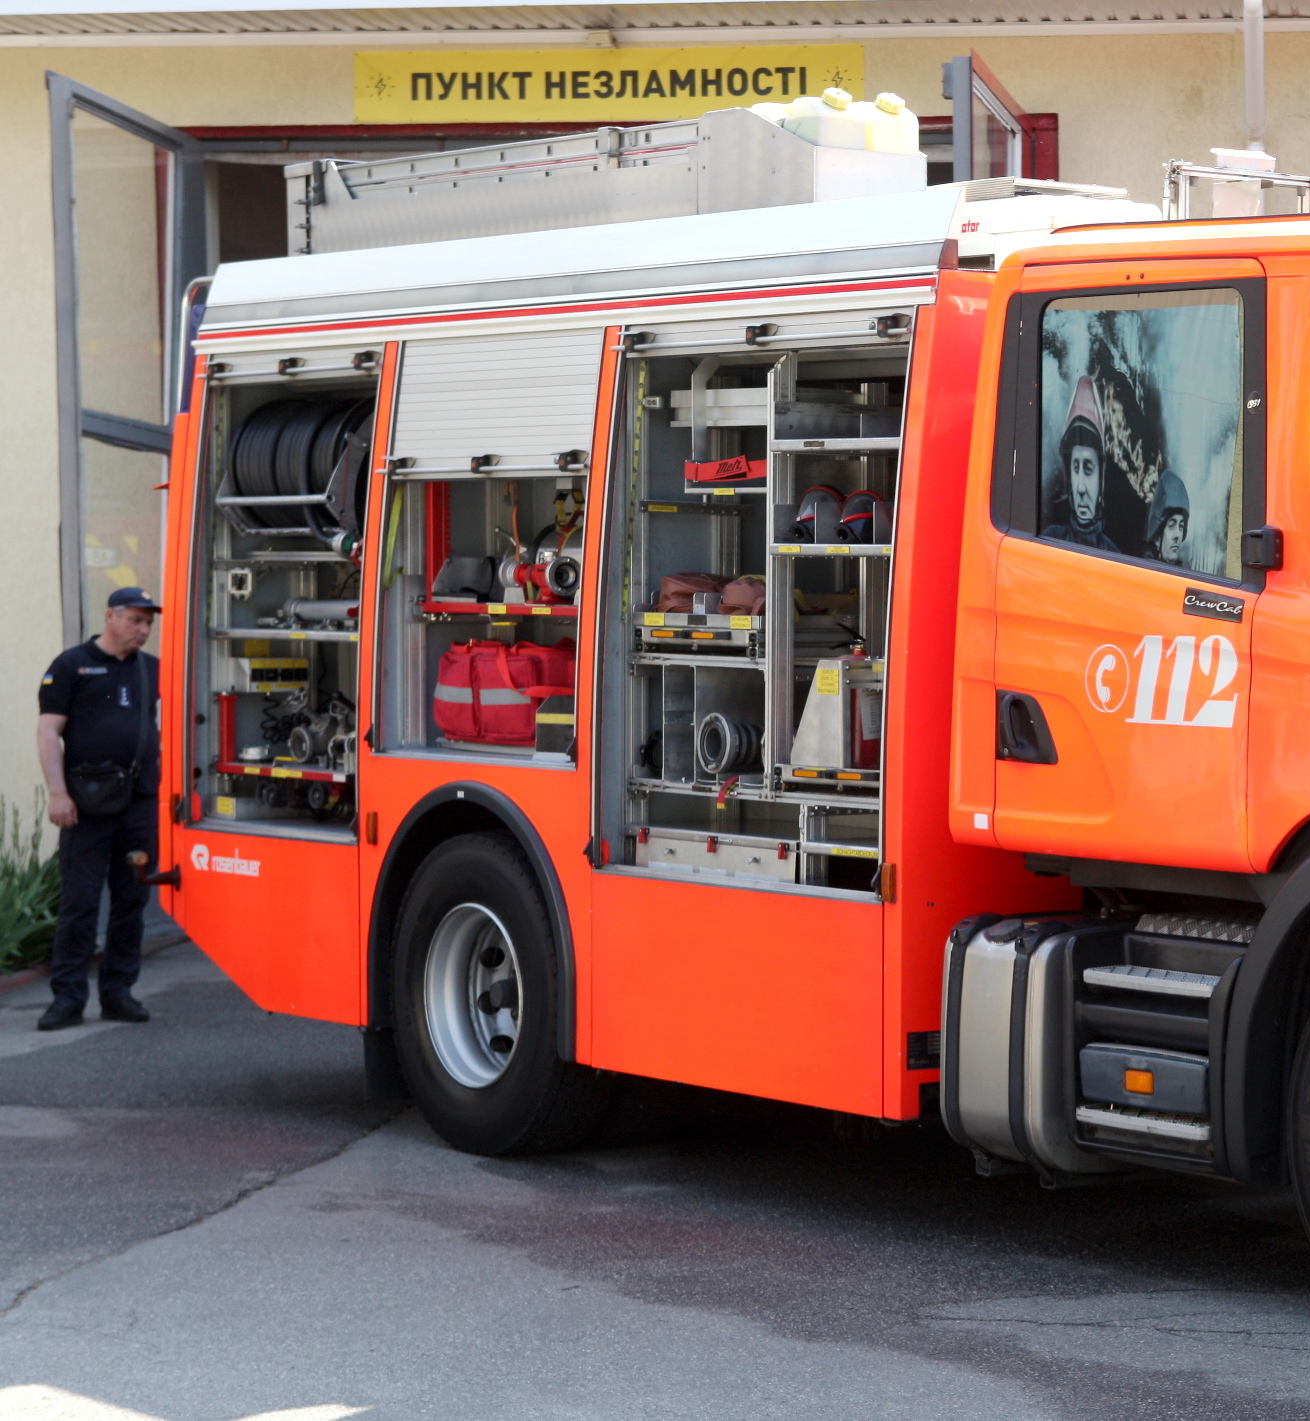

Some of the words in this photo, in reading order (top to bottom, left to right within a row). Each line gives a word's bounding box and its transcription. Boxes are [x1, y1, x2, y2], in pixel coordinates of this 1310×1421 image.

[411, 71, 533, 101] ПУНКТ
[544, 66, 808, 99] НЕЗЛАМНОСТІ
[1184, 595, 1243, 614] CrewCab
[1125, 634, 1239, 728] 112
[212, 848, 261, 877] rosenbauer
